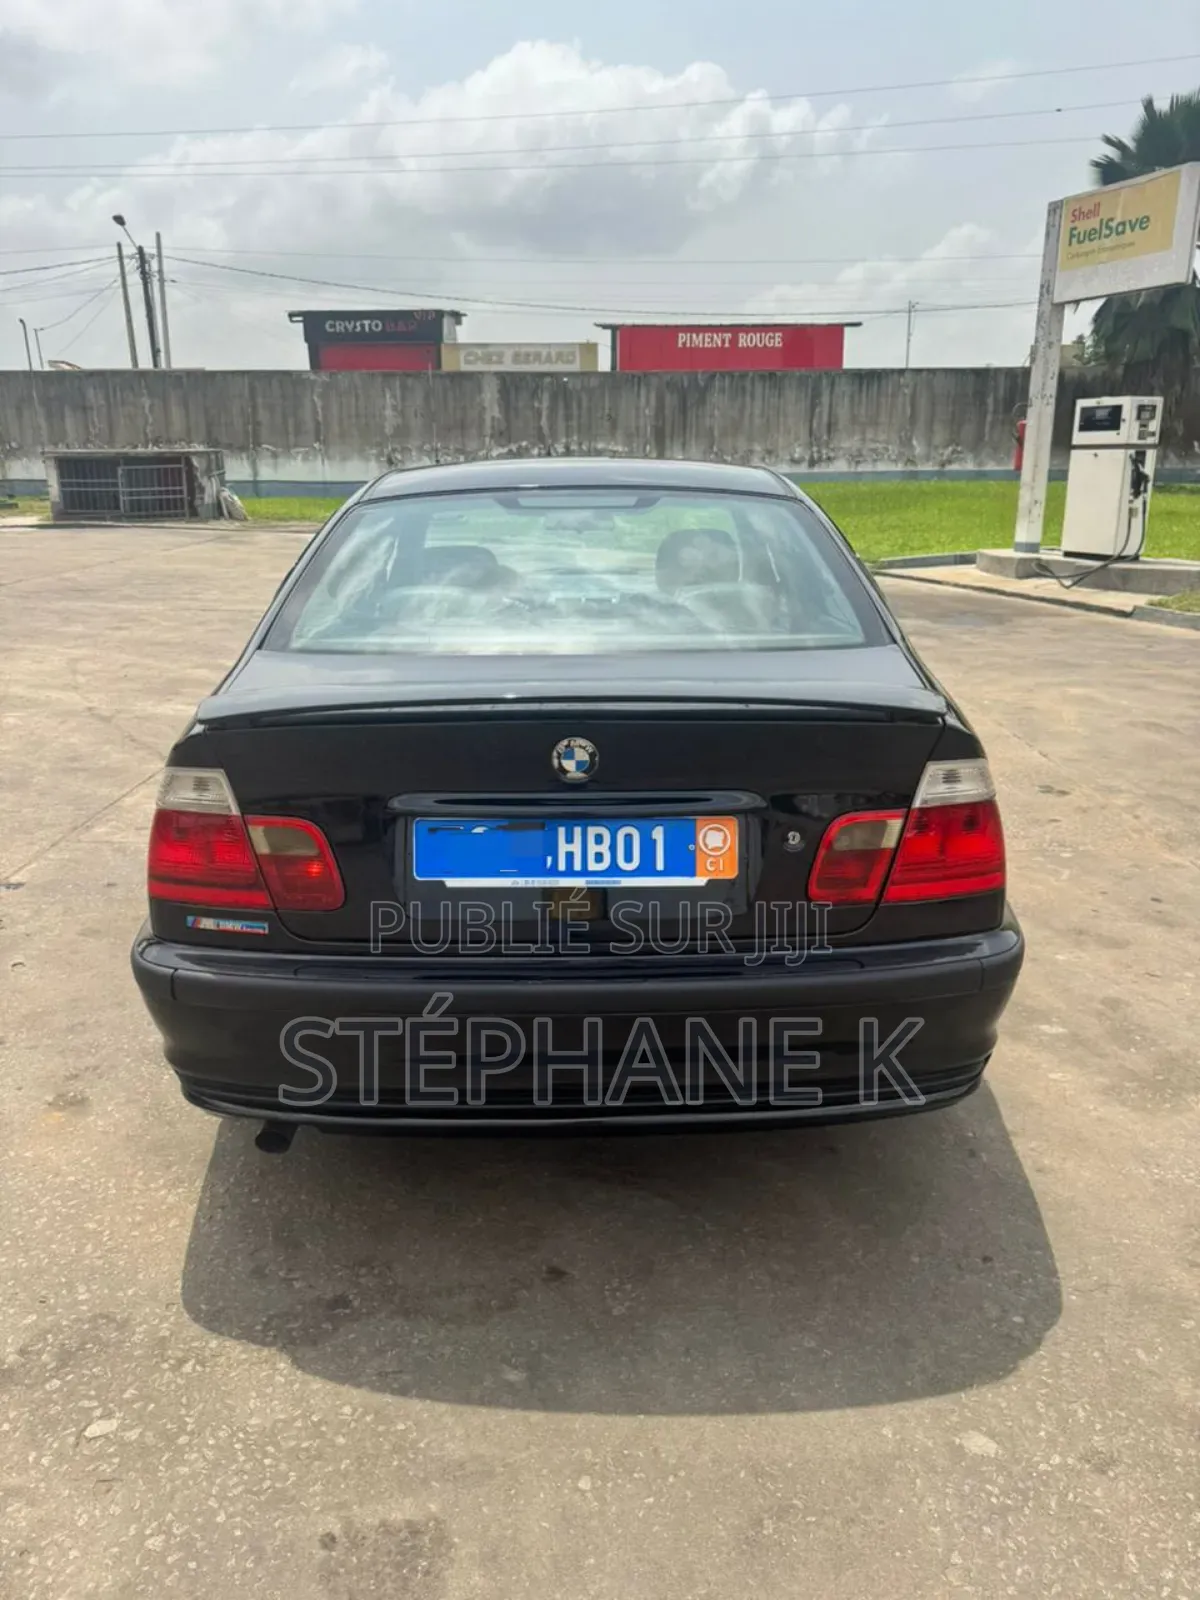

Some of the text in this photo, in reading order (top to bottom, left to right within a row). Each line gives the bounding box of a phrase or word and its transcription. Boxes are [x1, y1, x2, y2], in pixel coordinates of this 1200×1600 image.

[1070, 202, 1101, 223] Shell
[1067, 214, 1150, 247] FuelSave
[325, 320, 382, 333] CRYSTO
[677, 332, 783, 347] PIMENT ROUGE
